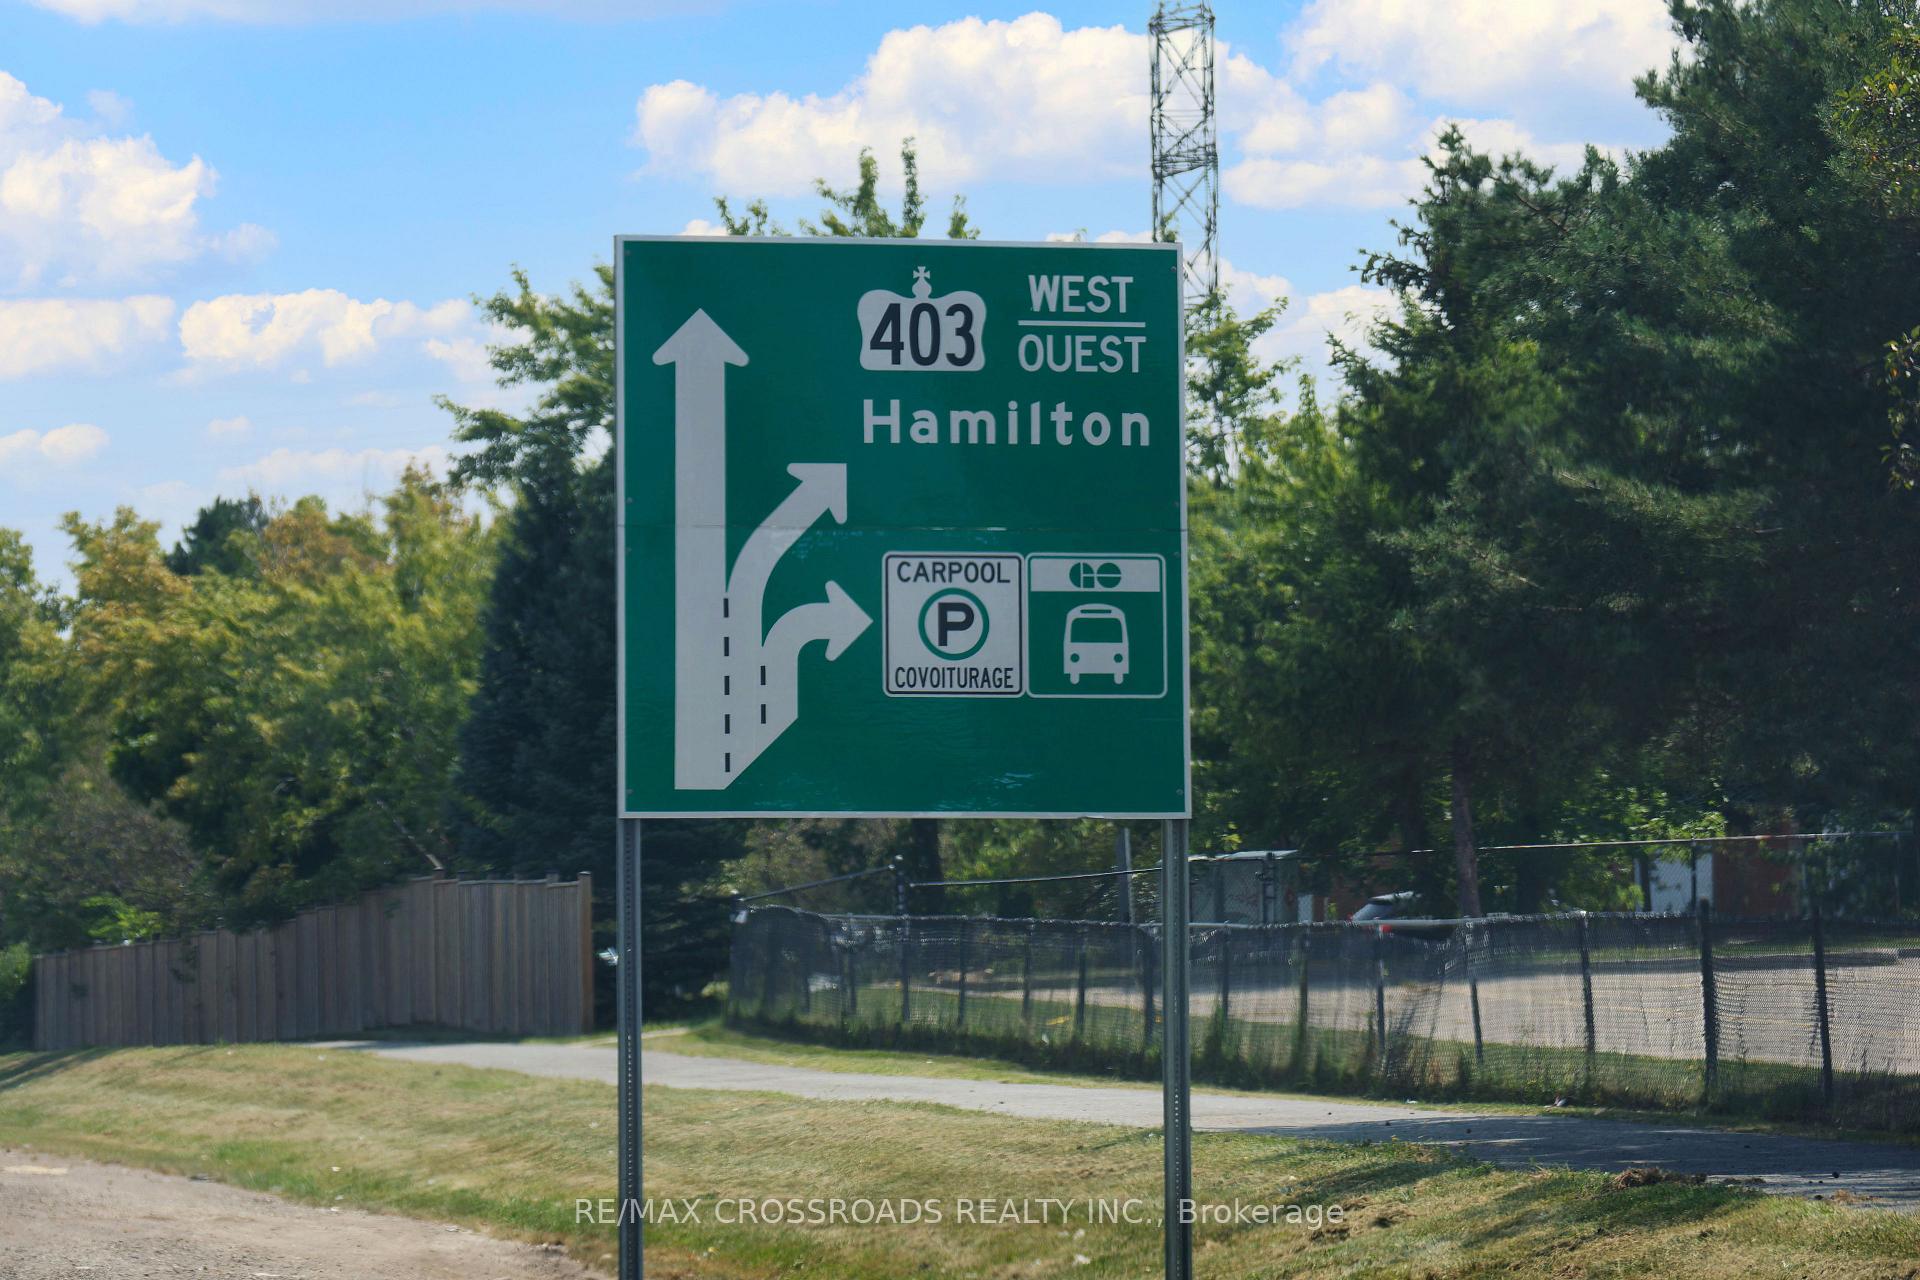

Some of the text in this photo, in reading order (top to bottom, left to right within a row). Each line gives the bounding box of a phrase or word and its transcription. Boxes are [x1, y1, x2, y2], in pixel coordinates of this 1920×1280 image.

[1028, 275, 1134, 313] WEST
[869, 302, 976, 366] 403
[1018, 334, 1146, 373] OUEST
[863, 399, 1150, 446] Hamilton
[897, 561, 1011, 584] CARPOOL
[938, 602, 975, 647] P
[895, 666, 1014, 689] COVOITURAGE
